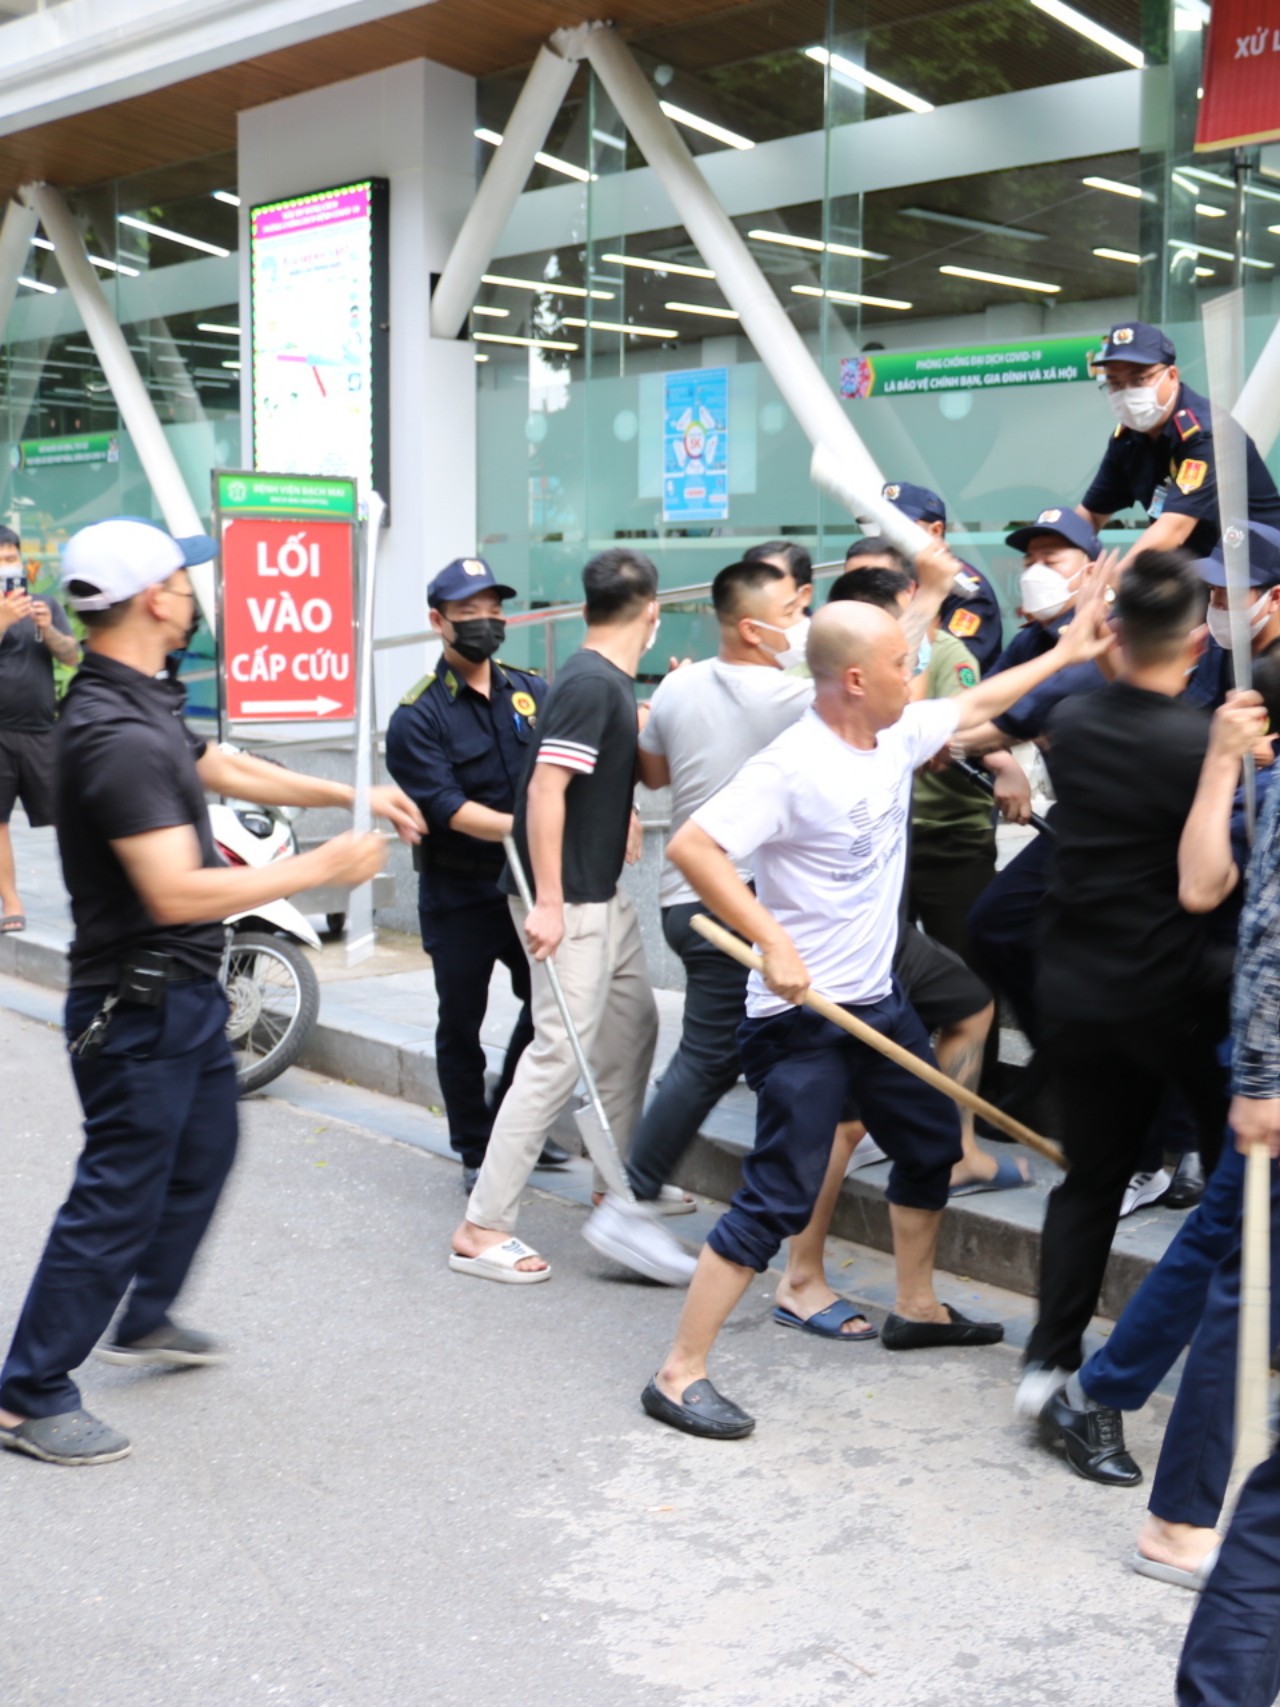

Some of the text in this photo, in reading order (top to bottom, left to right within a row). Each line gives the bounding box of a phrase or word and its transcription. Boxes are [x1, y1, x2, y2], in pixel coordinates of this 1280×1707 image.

[1234, 26, 1268, 59] XỬ
[257, 531, 320, 578] LỐI
[246, 591, 332, 633] VÀO
[231, 644, 349, 682] CẤP CỨU
